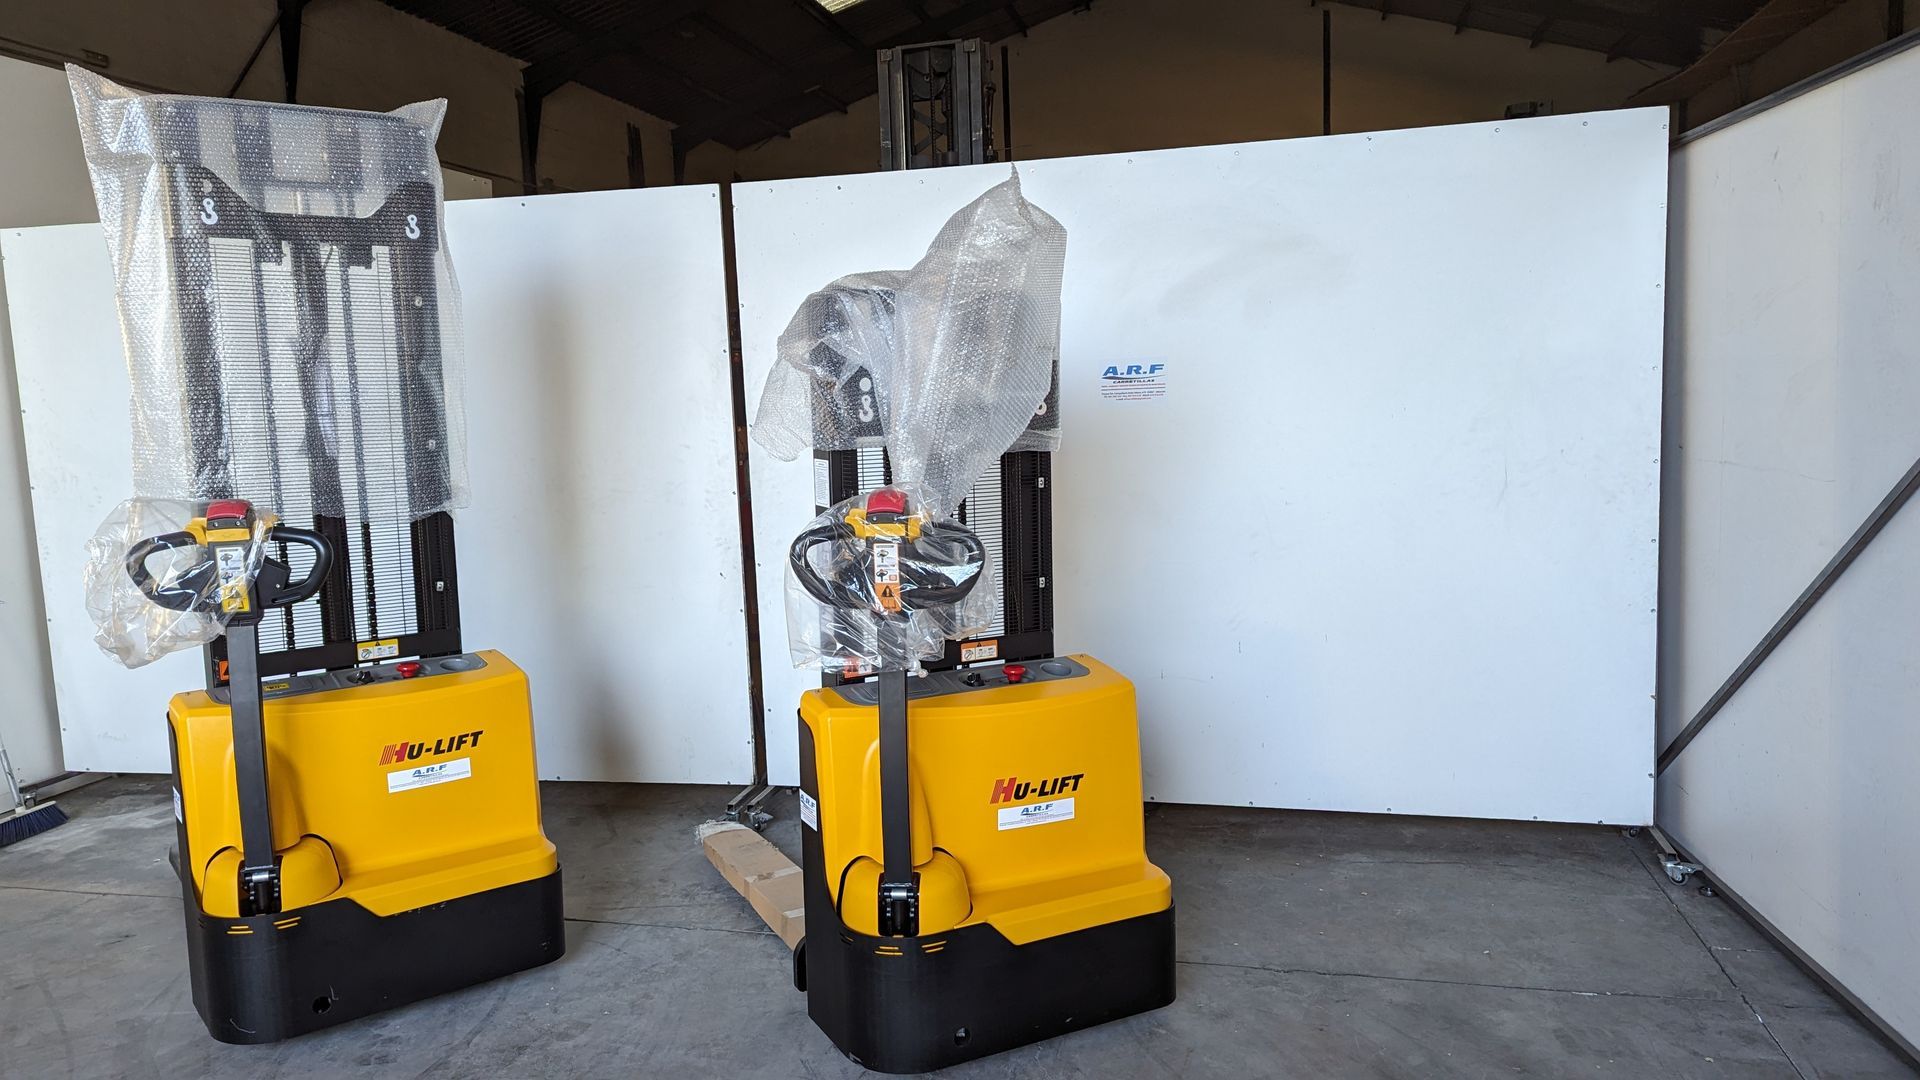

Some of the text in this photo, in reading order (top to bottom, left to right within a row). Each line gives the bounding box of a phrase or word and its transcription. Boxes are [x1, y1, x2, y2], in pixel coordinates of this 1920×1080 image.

[1102, 363, 1165, 377] A.R.F
[379, 730, 484, 766] HU-LIFT
[412, 763, 448, 775] A.R.F
[990, 773, 1085, 804] HU-LIFT
[1021, 803, 1054, 814] A.R.F
